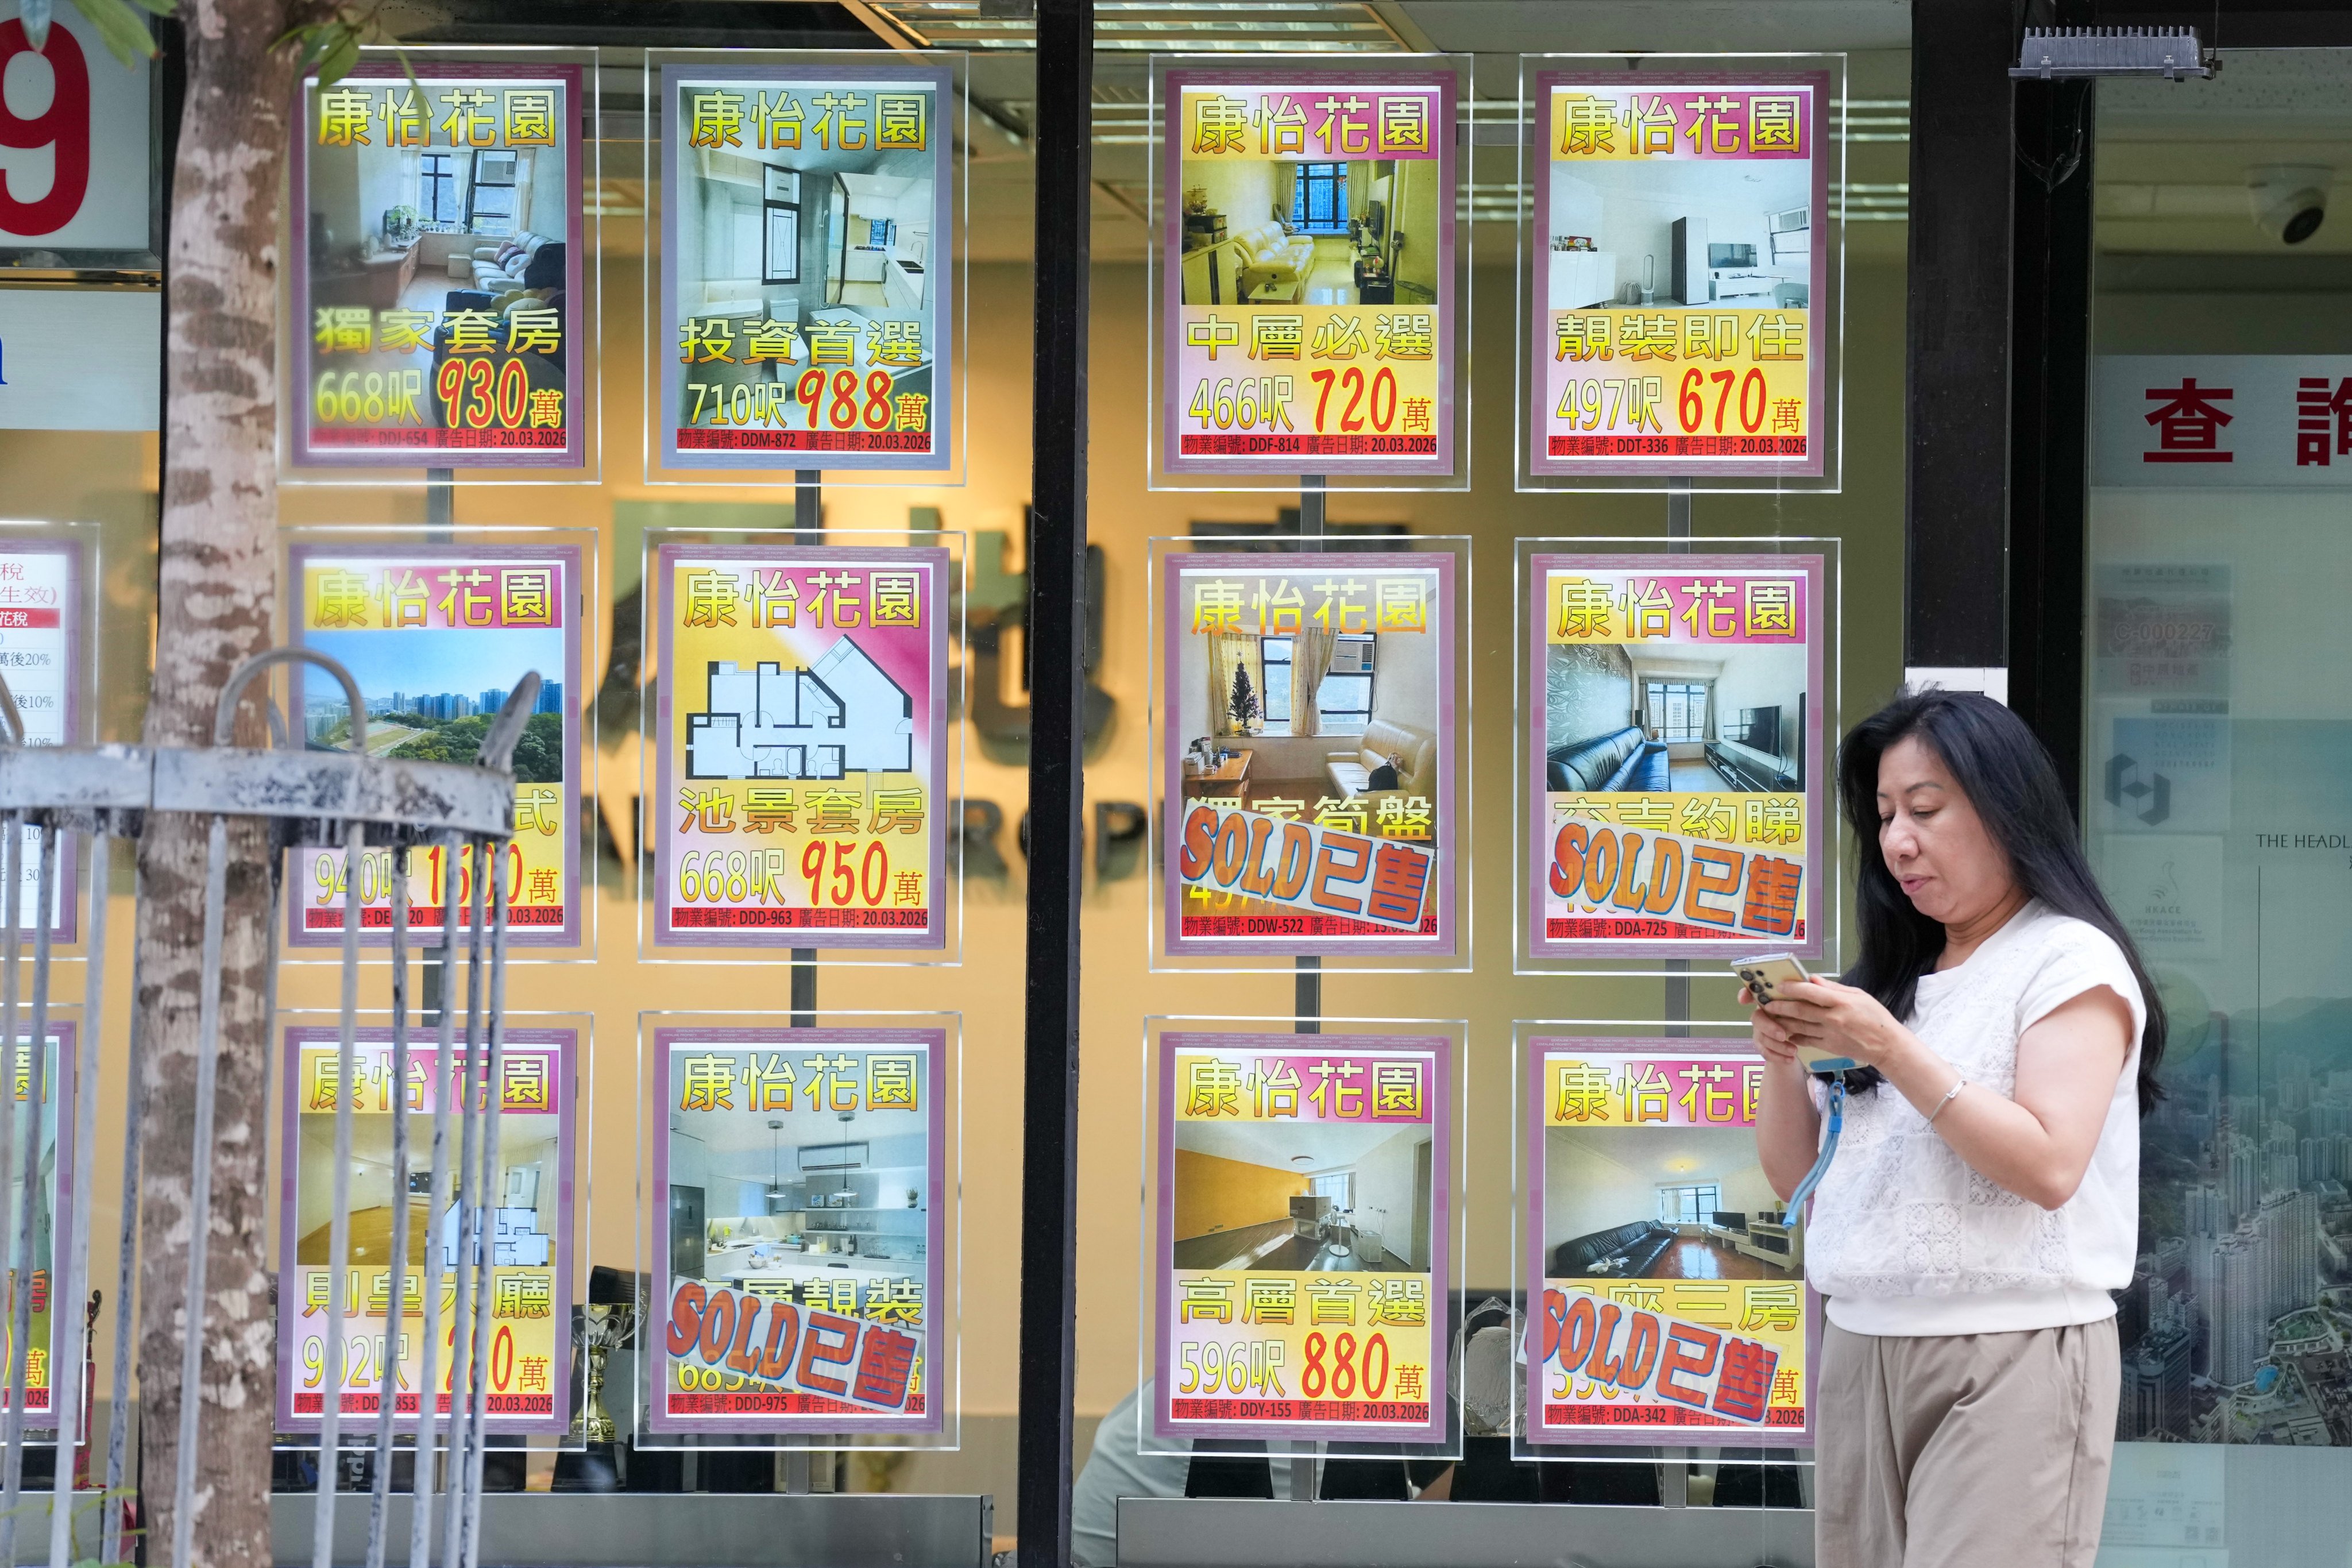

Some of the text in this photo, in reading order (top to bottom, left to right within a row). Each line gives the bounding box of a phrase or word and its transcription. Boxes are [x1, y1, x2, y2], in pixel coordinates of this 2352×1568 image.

[318, 88, 555, 146] 康怡花園
[689, 90, 926, 151] 康怡花園
[1191, 95, 1428, 154] 康怡花園
[1561, 95, 1801, 154] 康怡花園
[315, 308, 562, 354] 獨家套房
[679, 318, 922, 366] 投資首選
[1187, 314, 1432, 361] 中層必選
[1555, 314, 1803, 362] 靚裝即住
[317, 358, 563, 428] 668呎 930萬
[688, 369, 927, 430] 710呎 988萬
[1189, 366, 1430, 433] 466呎 720萬
[1557, 368, 1801, 434] 497呎 670萬
[500, 431, 566, 446] 20.03.2026
[678, 430, 930, 451] 物業編號: DDM-872 廣告日期: 20.03.2026
[1184, 435, 1436, 454] 物業編號: DDF-814 廣告日期: 20.03.2026
[1551, 437, 1806, 455] 物業編號: DDT-336 廣告日期: 20.03.2026
[314, 569, 551, 627] 康怡花園
[683, 570, 921, 628] 康怡花園
[1191, 578, 1426, 636] 康怡花園
[1558, 580, 1796, 638] 康怡花園
[2115, 622, 2215, 641] C-000227
[11, 694, 54, 709] 後10%
[678, 787, 924, 834] 池景套房
[2256, 834, 2352, 848] THE HEADL
[680, 840, 922, 906] 668呎 950萬
[374, 910, 423, 925] DE20
[675, 909, 927, 927] 物業編號: DDD-963 廣告日期: 20.03.2026
[1184, 917, 1244, 935] 物業編號:
[1248, 918, 1303, 933] DDW-522
[1550, 920, 1611, 937] 物業編號:
[1615, 921, 1667, 936] DDA-725
[2145, 906, 2181, 914] HKACE
[679, 1053, 917, 1111] 康怡花園
[1185, 1059, 1423, 1119] 康怡花園
[700, 1277, 924, 1325] 靚裝
[1179, 1277, 1426, 1327] 高層首選
[1180, 1331, 1424, 1400] 596呎 880萬
[296, 1394, 359, 1413] 物業號:
[362, 1396, 416, 1411] DD853
[488, 1397, 553, 1411] 20.03.2026
[671, 1395, 731, 1413] 物業編號:
[735, 1396, 787, 1411] DDD-975
[1175, 1400, 1429, 1421] 物業編號: DDY-155 廣告日期: 20.03.2026
[1548, 1406, 1609, 1425] 物業編號:
[1614, 1408, 1666, 1423] DDA-342
